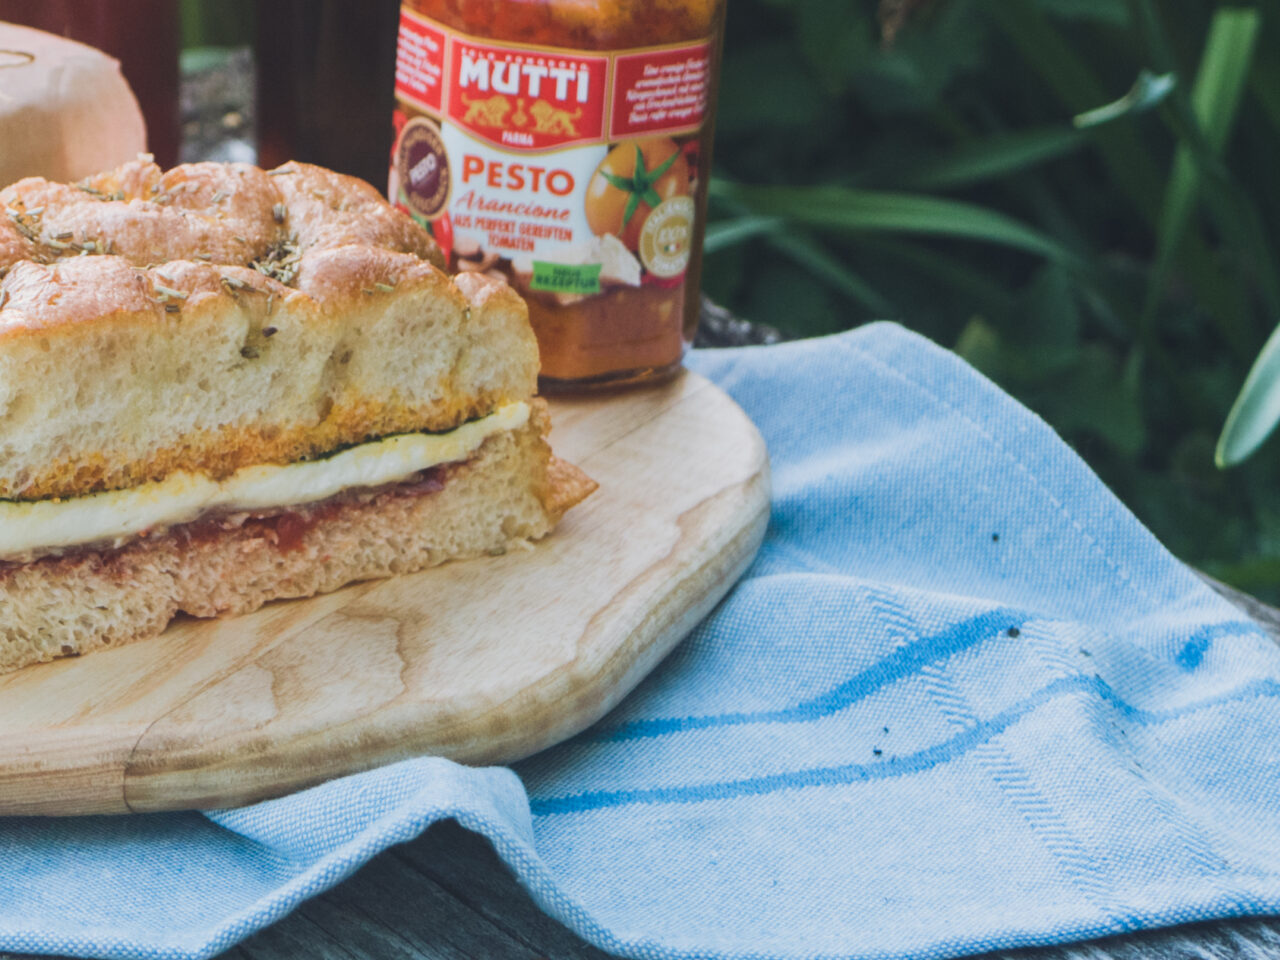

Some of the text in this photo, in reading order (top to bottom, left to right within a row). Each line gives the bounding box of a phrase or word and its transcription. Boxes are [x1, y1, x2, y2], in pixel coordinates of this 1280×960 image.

[459, 55, 589, 103] MUTTI
[502, 131, 534, 146] PARMA
[462, 154, 575, 196] PESTO
[455, 189, 571, 221] Arancione
[474, 216, 517, 234] PERFEKT
[519, 221, 573, 242] GEREIFTEN
[487, 233, 535, 252] TOMATEN
